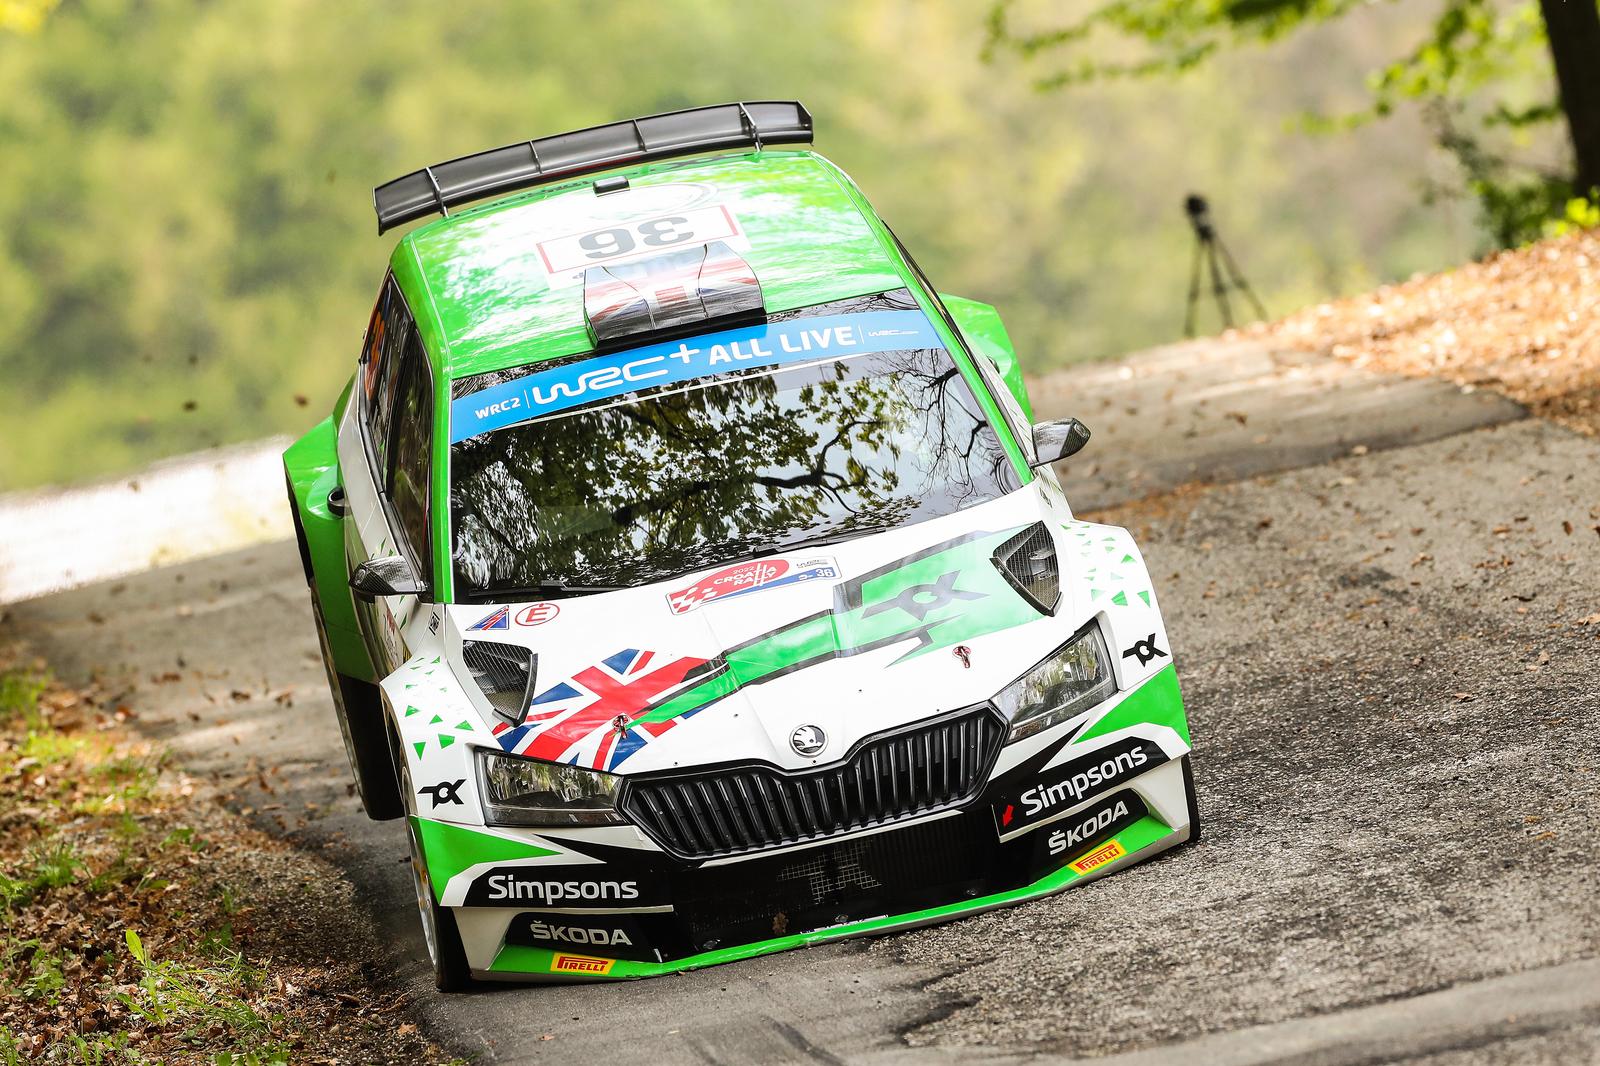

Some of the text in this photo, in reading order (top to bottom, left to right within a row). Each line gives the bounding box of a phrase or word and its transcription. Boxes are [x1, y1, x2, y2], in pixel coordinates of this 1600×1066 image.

[578, 216, 694, 259] 36
[475, 397, 521, 420] WRC2
[708, 337, 773, 367] ALL
[779, 326, 856, 353] LIVE
[815, 567, 834, 577] 36
[1020, 745, 1148, 817] Simpsons
[1048, 799, 1129, 856] ŠKODA
[1075, 842, 1120, 872] PIRELLI
[488, 874, 639, 905] Simpsons
[529, 919, 633, 946] ŠKODA
[556, 955, 609, 972] PIRELLI
